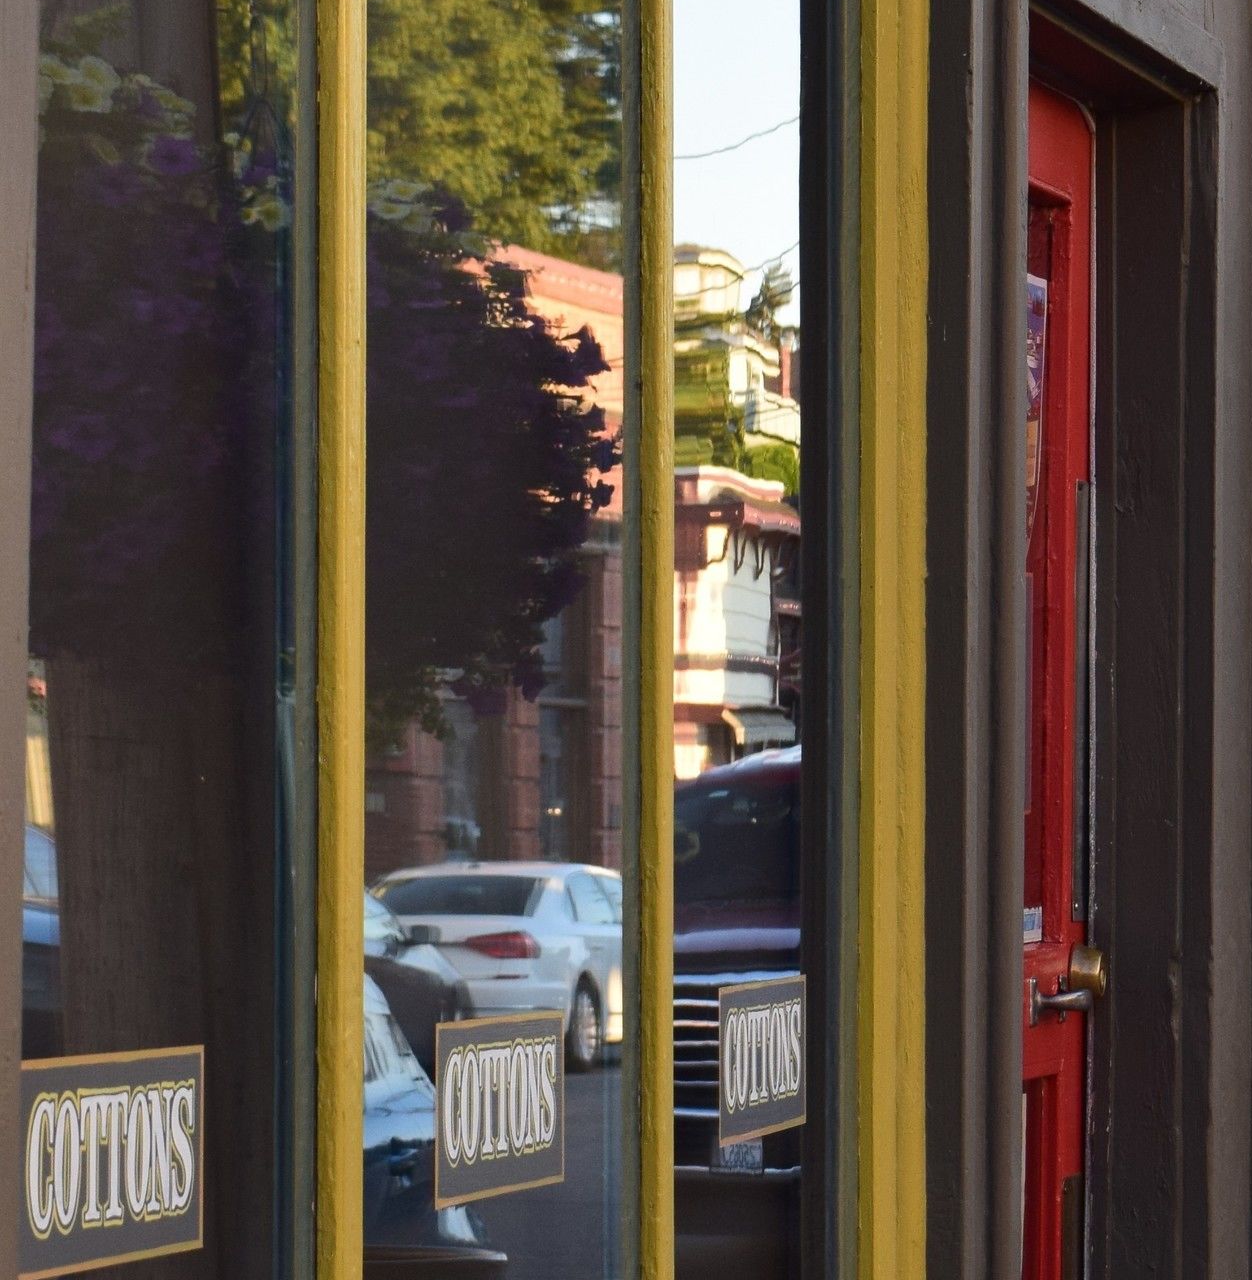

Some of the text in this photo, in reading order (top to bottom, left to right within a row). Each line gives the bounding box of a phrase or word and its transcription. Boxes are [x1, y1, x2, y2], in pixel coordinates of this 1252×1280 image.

[443, 1035, 557, 1168] COTTONS
[724, 998, 801, 1114] COTTONS
[26, 1078, 195, 1240] COTTONS
